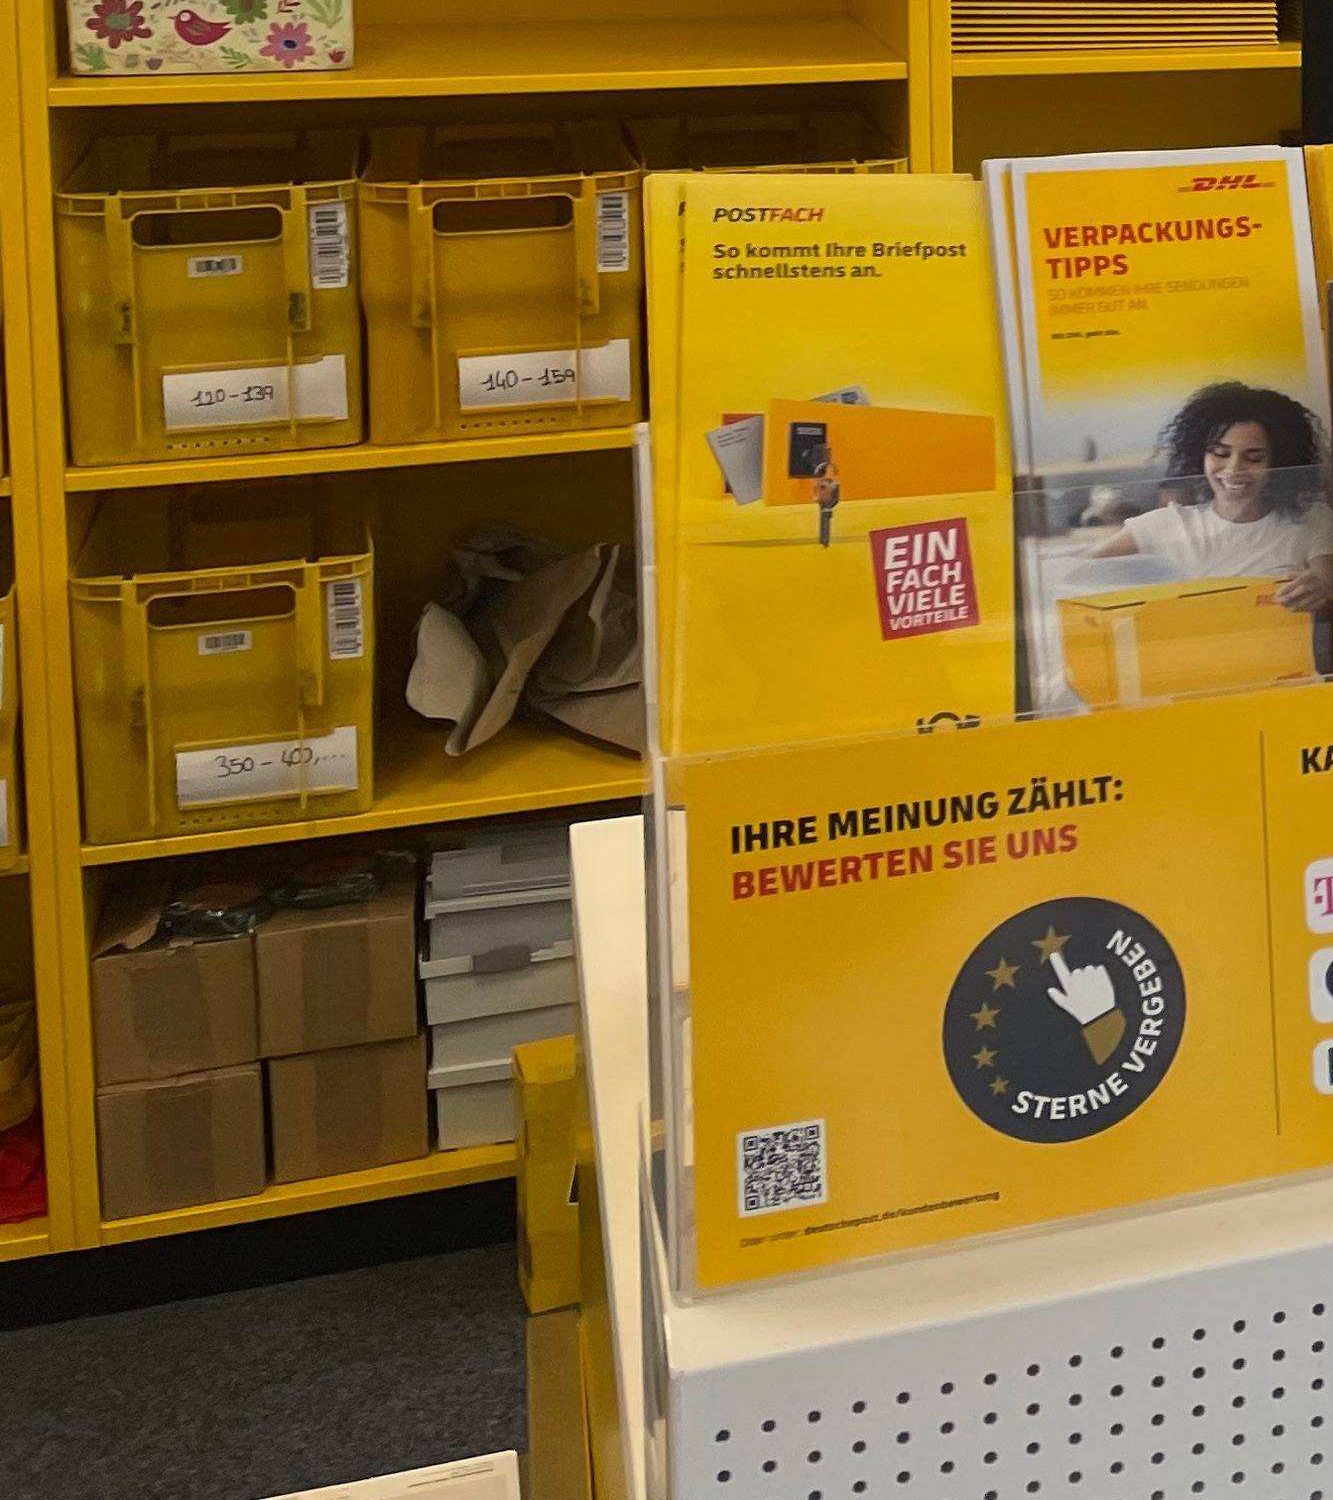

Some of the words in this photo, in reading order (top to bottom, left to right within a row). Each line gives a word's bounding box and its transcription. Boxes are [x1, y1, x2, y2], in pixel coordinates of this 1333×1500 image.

[1191, 174, 1262, 192] DHL
[712, 207, 825, 222] POSTFACH
[1044, 215, 1262, 249] VERPACKUNGS-
[713, 243, 739, 258] So
[745, 243, 820, 258] kommt
[825, 243, 866, 257] Ihre
[871, 242, 966, 260] Briefpost
[713, 263, 846, 280] schnellstens
[850, 265, 881, 278] an.
[1046, 254, 1128, 280] TIPPS
[884, 527, 958, 570] EIN
[886, 561, 962, 594] FACH
[886, 583, 966, 616] VIELE
[889, 605, 969, 631] VORTEILE
[214, 755, 254, 778] 350
[731, 815, 818, 855] IHRE
[828, 791, 1000, 840] MEINUNG
[1007, 776, 1124, 816] ZÄHLT:
[732, 844, 934, 900] BEWERTEN
[943, 835, 998, 869] SIE
[1007, 824, 1079, 859] UNS
[1011, 1072, 1129, 1120] STERNE
[1106, 929, 1165, 1073] VERGEBEN
